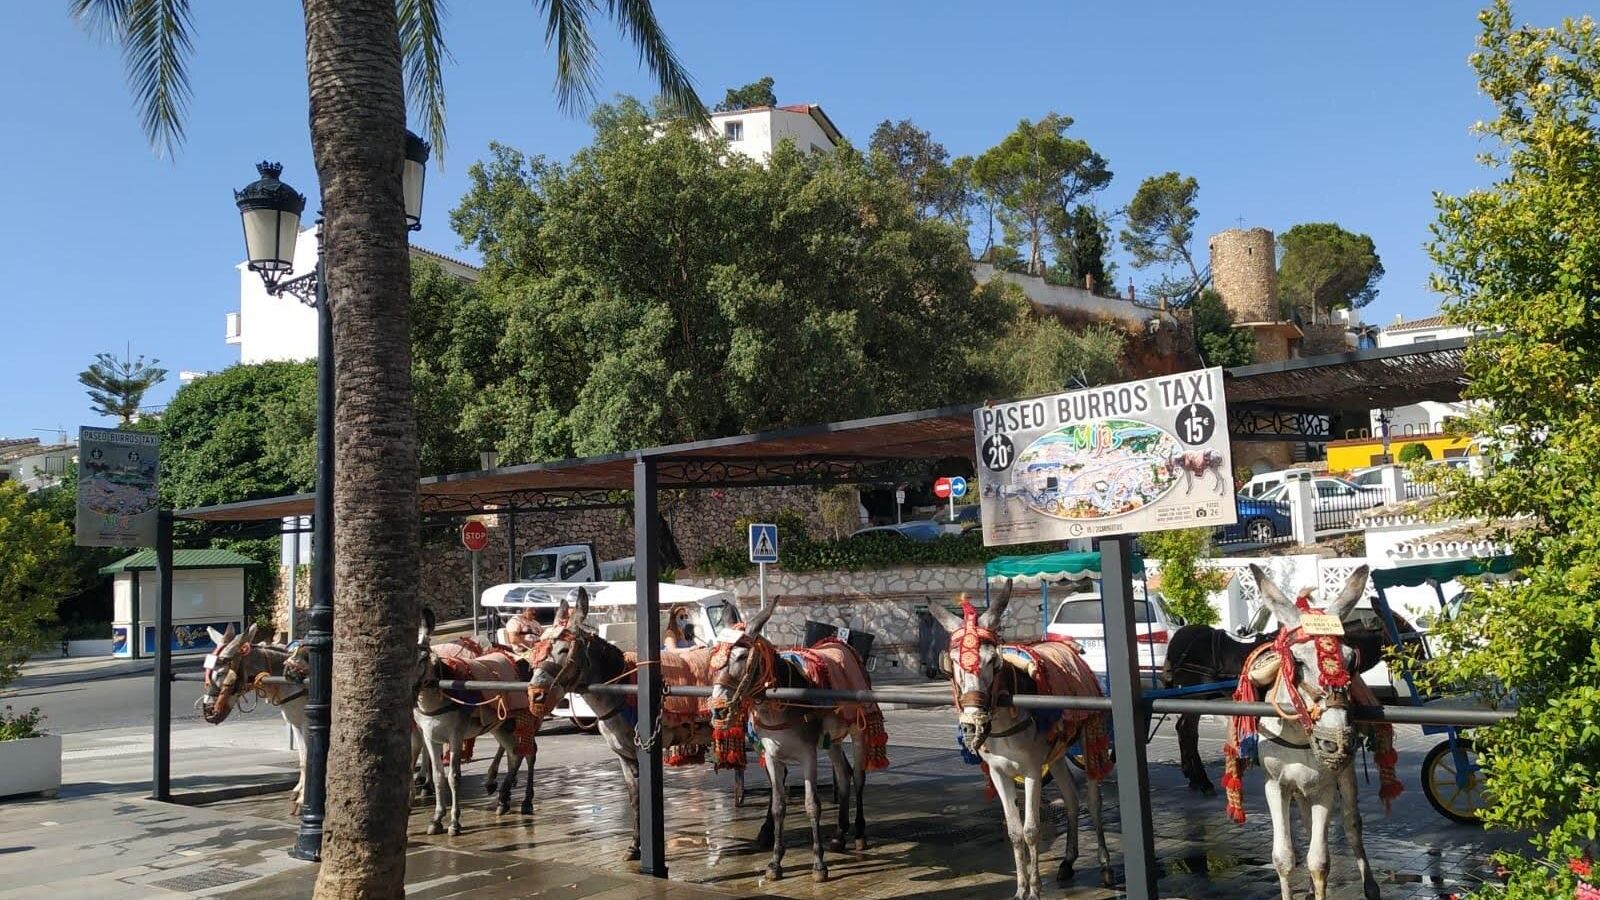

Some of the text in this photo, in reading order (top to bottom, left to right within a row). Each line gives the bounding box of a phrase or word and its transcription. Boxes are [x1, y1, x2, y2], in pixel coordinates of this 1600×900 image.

[983, 402, 1045, 435] PASEO
[1057, 384, 1148, 423] BURROS
[84, 431, 158, 446] PASEO BURROS TAXI
[1073, 421, 1122, 458] Mijas
[1184, 417, 1210, 443] 15€
[988, 444, 1012, 469] 20€
[465, 532, 486, 540] STOP
